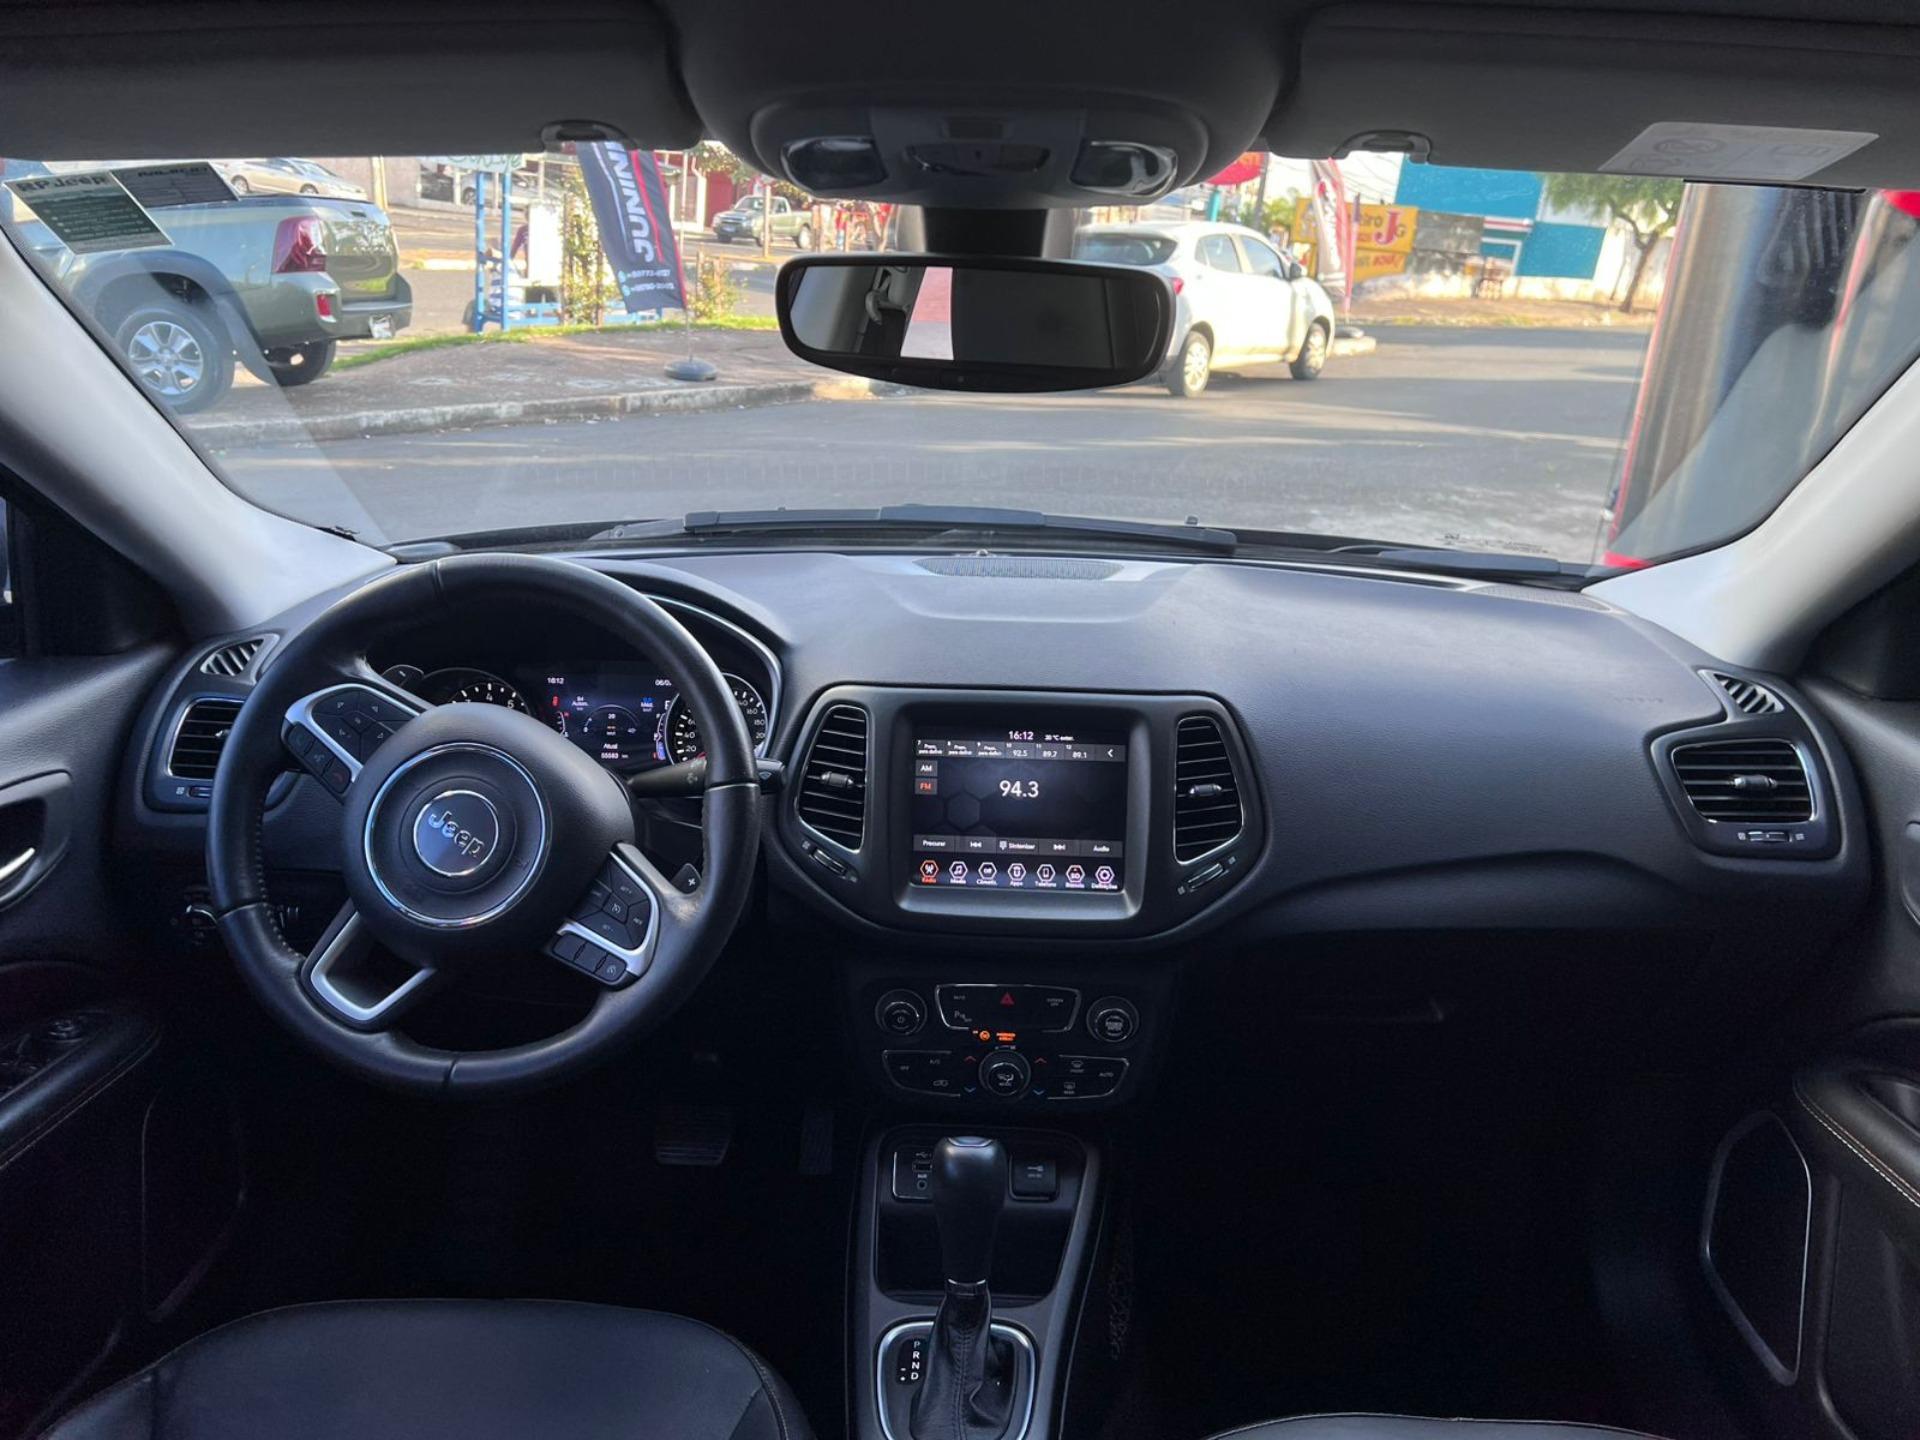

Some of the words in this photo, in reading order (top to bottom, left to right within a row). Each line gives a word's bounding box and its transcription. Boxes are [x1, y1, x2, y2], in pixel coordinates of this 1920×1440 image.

[1008, 730, 1034, 741] 16:12
[1013, 749, 1028, 757] 92.5
[1042, 750, 1057, 758] 89.7
[1072, 751, 1087, 759] 89.1
[920, 764, 932, 772] AM
[999, 780, 1039, 798] 94.3
[428, 810, 485, 856] Jeep
[913, 1340, 921, 1349] P
[912, 1350, 920, 1360] R
[911, 1361, 920, 1370] N
[910, 1371, 919, 1380] D
